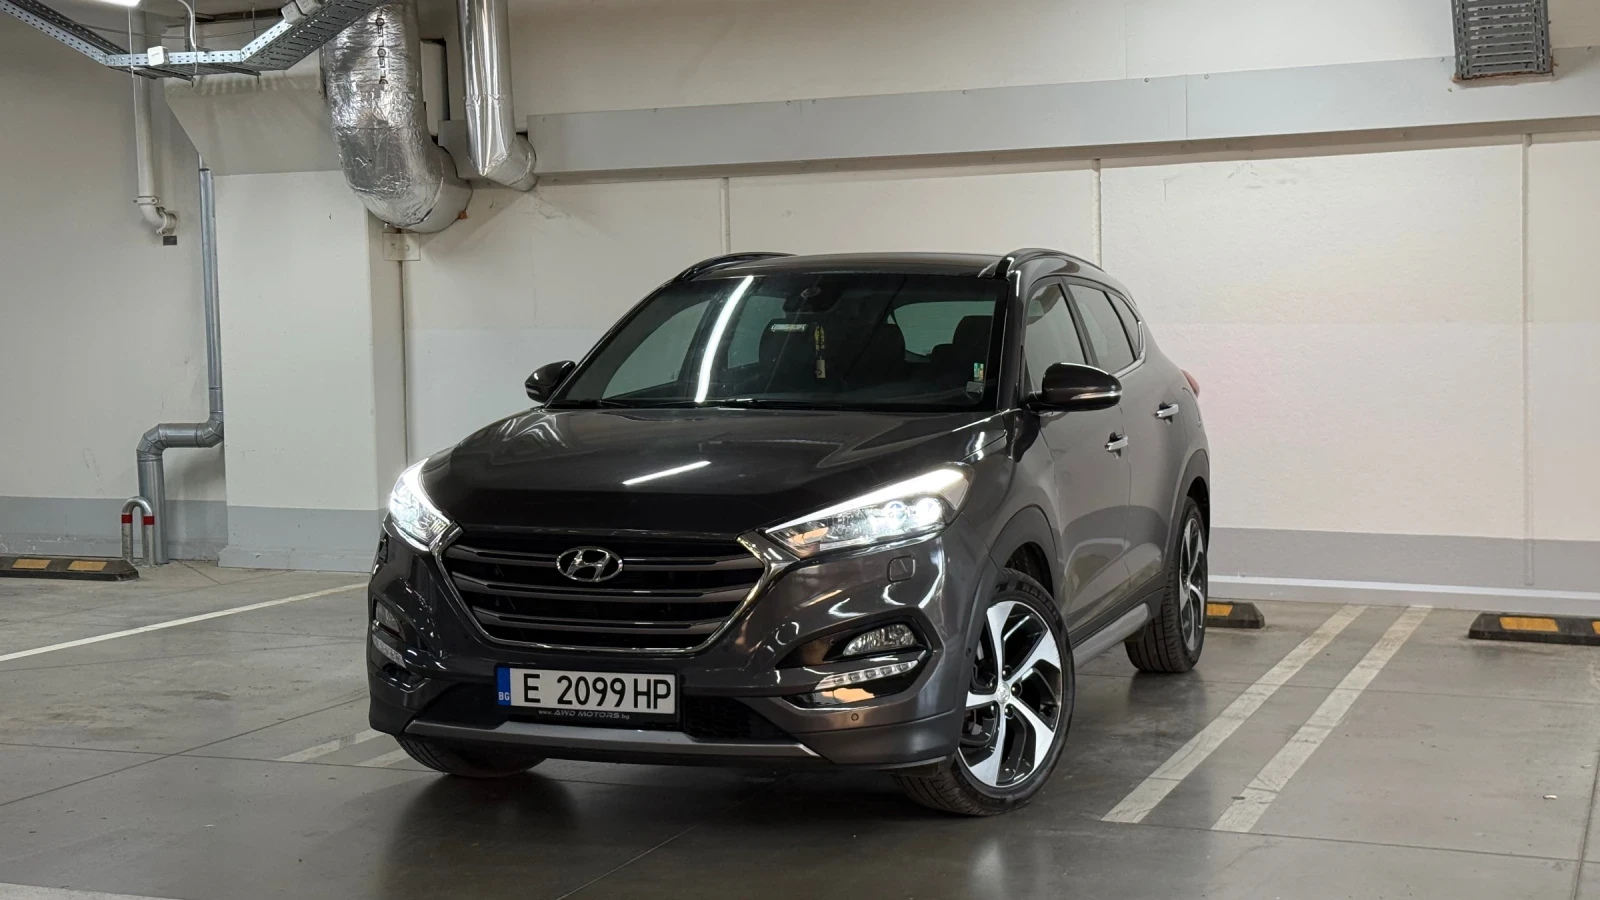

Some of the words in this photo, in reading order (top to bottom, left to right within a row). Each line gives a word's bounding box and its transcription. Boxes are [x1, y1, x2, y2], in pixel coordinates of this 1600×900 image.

[498, 691, 510, 701] BG
[523, 673, 541, 704] E
[556, 675, 627, 708] 2099
[633, 678, 672, 710] HP
